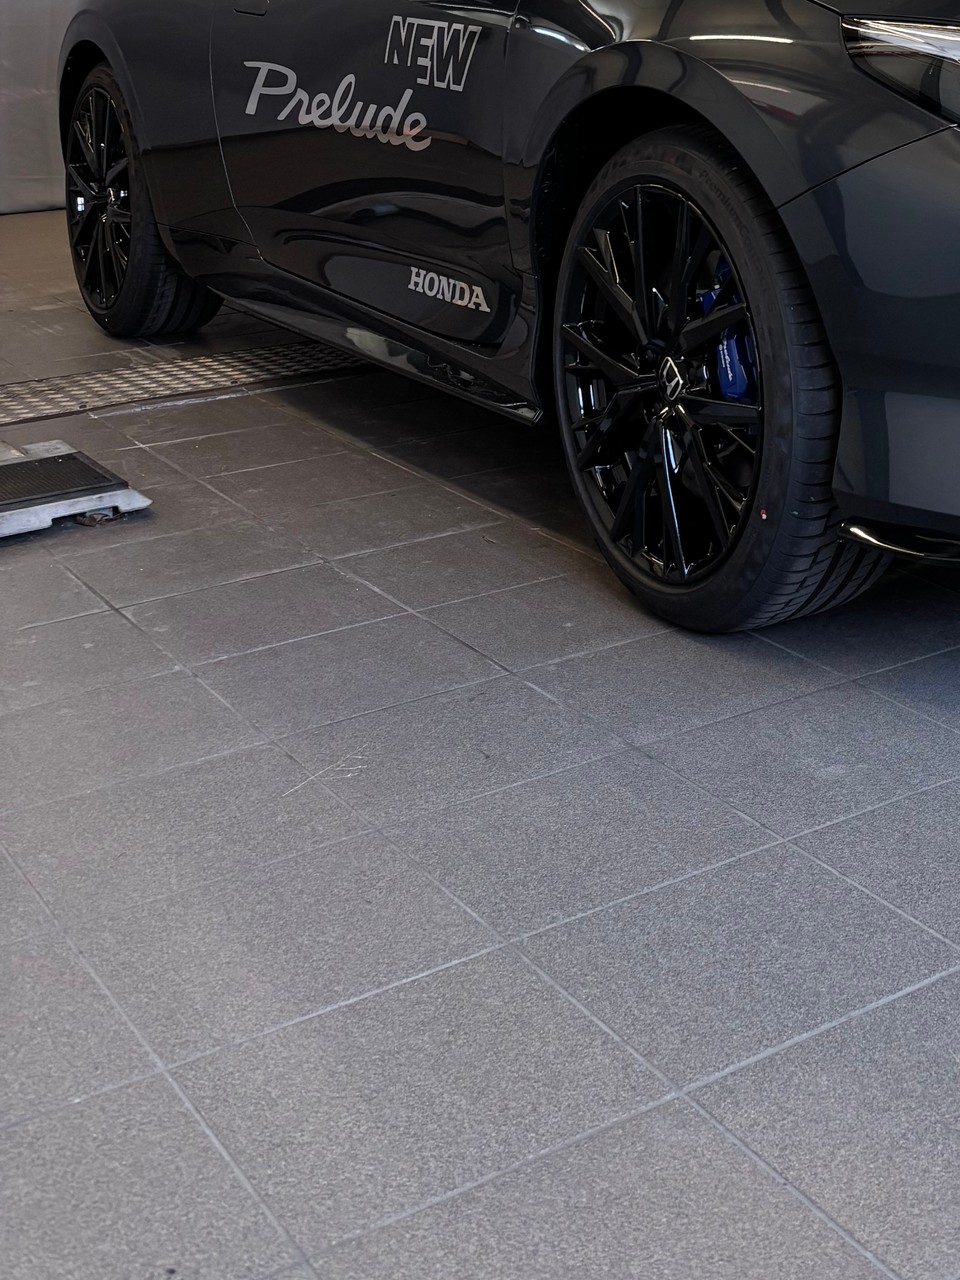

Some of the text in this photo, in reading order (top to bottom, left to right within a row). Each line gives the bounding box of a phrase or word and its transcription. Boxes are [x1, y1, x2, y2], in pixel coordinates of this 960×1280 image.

[384, 15, 482, 92] NEW
[243, 61, 432, 151] Prelude
[407, 266, 491, 312] HONDA
